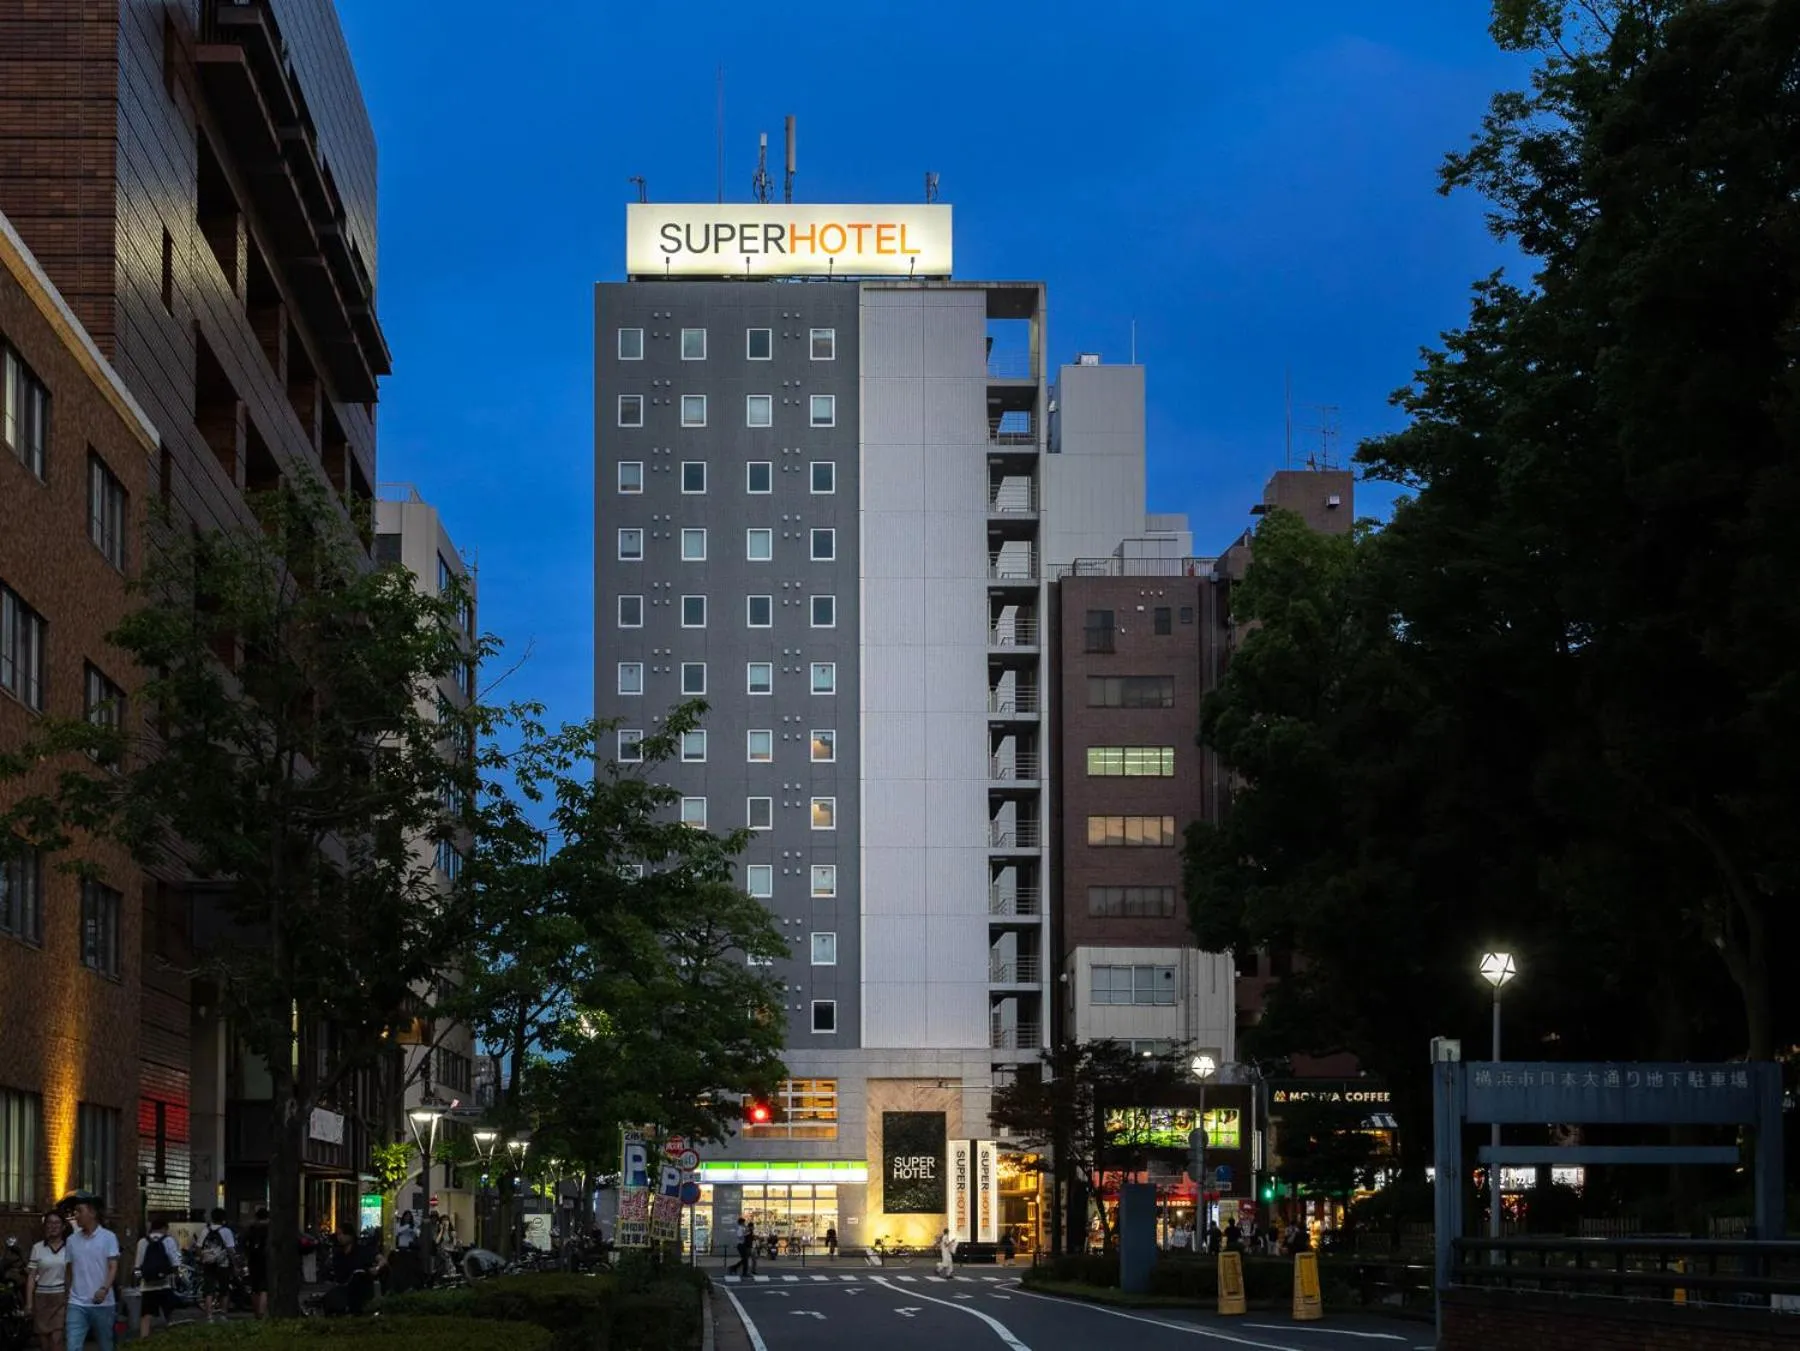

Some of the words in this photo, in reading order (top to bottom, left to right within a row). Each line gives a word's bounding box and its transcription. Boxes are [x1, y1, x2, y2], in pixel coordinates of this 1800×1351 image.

[660, 223, 921, 254] SUPERHOTEL
[1345, 1091, 1390, 1102] COFFEE
[626, 1145, 647, 1187] P
[893, 1156, 935, 1168] SUPER
[661, 1165, 680, 1196] P
[893, 1167, 935, 1180] HOTEL
